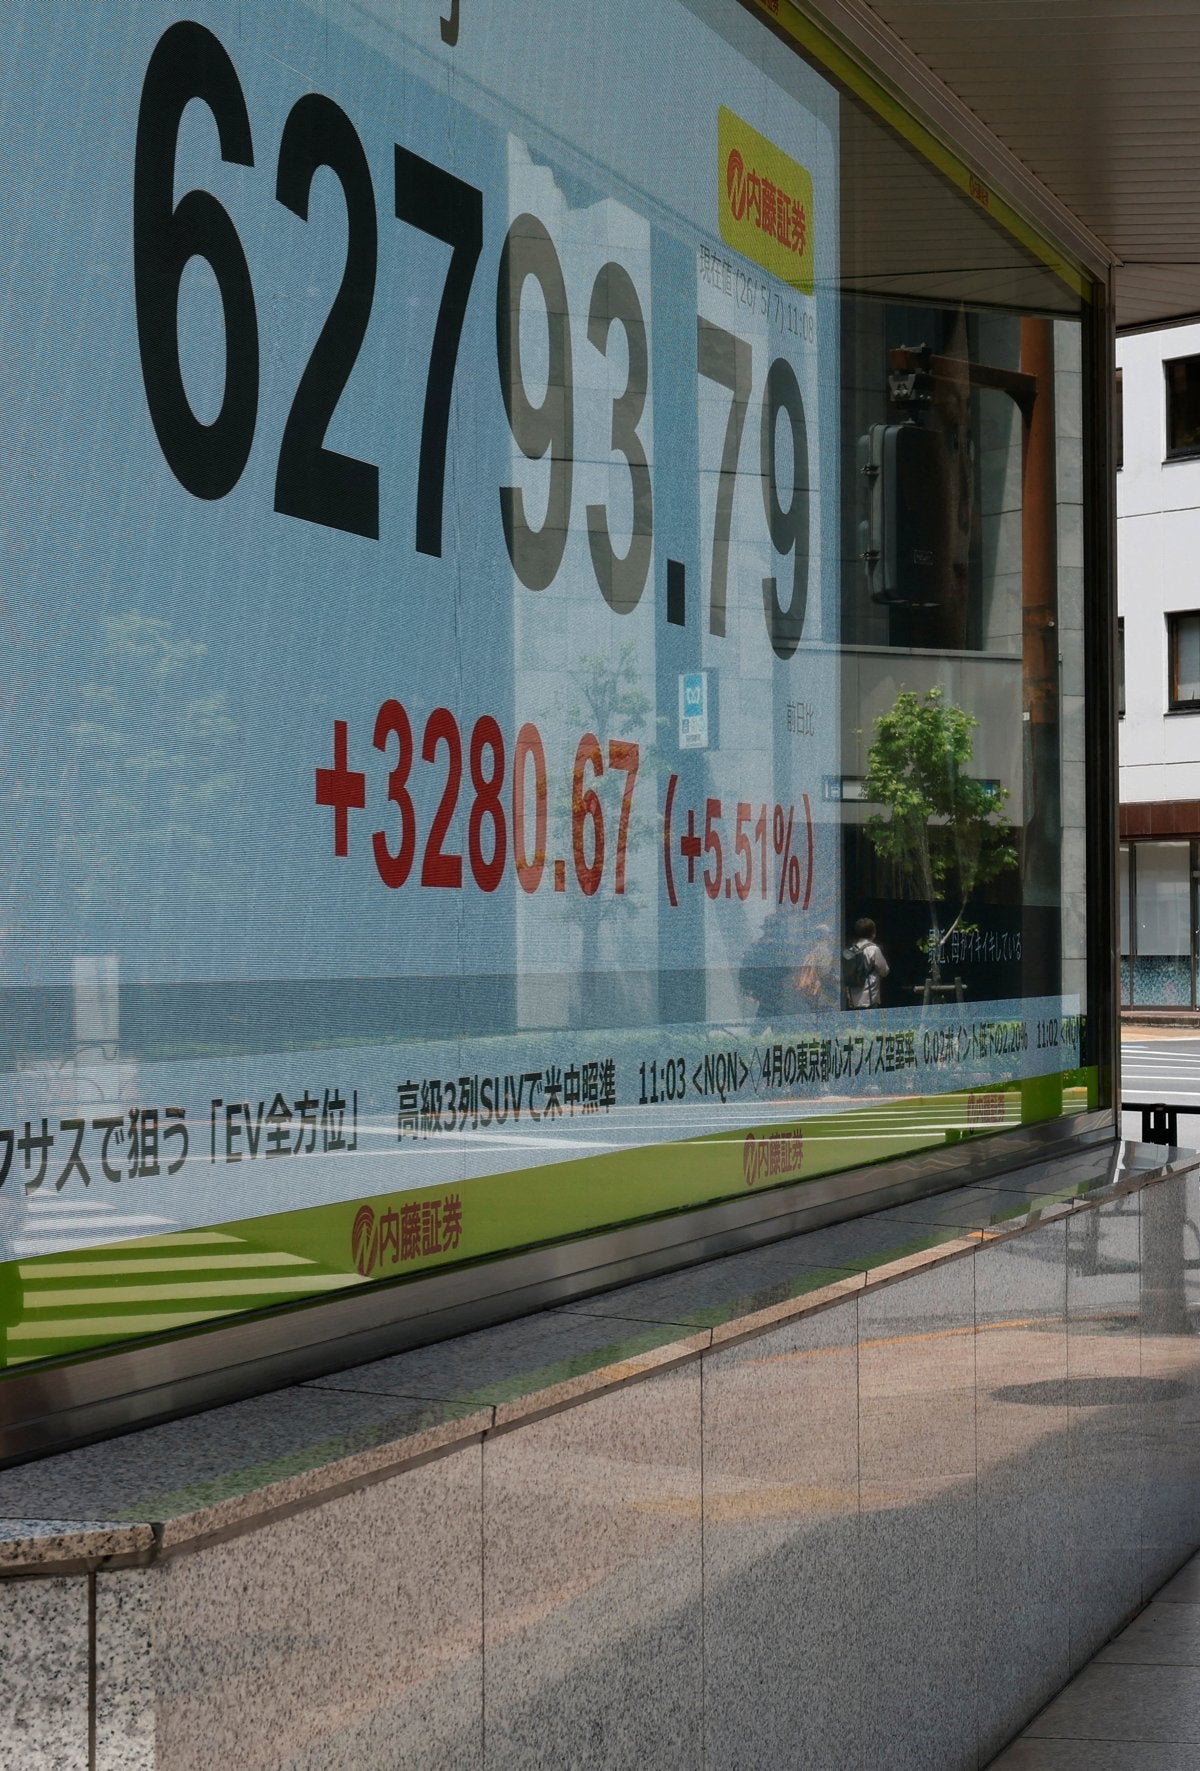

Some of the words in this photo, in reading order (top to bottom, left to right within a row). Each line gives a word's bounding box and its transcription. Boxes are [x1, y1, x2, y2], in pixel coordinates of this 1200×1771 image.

[747, 168, 806, 257] 内藤証券
[133, 20, 809, 660] 62793.79
[315, 699, 640, 897] +3280.67
[664, 774, 814, 911] (+5.51%)
[398, 1059, 616, 1142] 高級3列SUVで米中照準
[639, 1058, 686, 1104] 11:03
[756, 1128, 804, 1182] 内藤証券
[378, 1194, 463, 1264] 内藤証券
